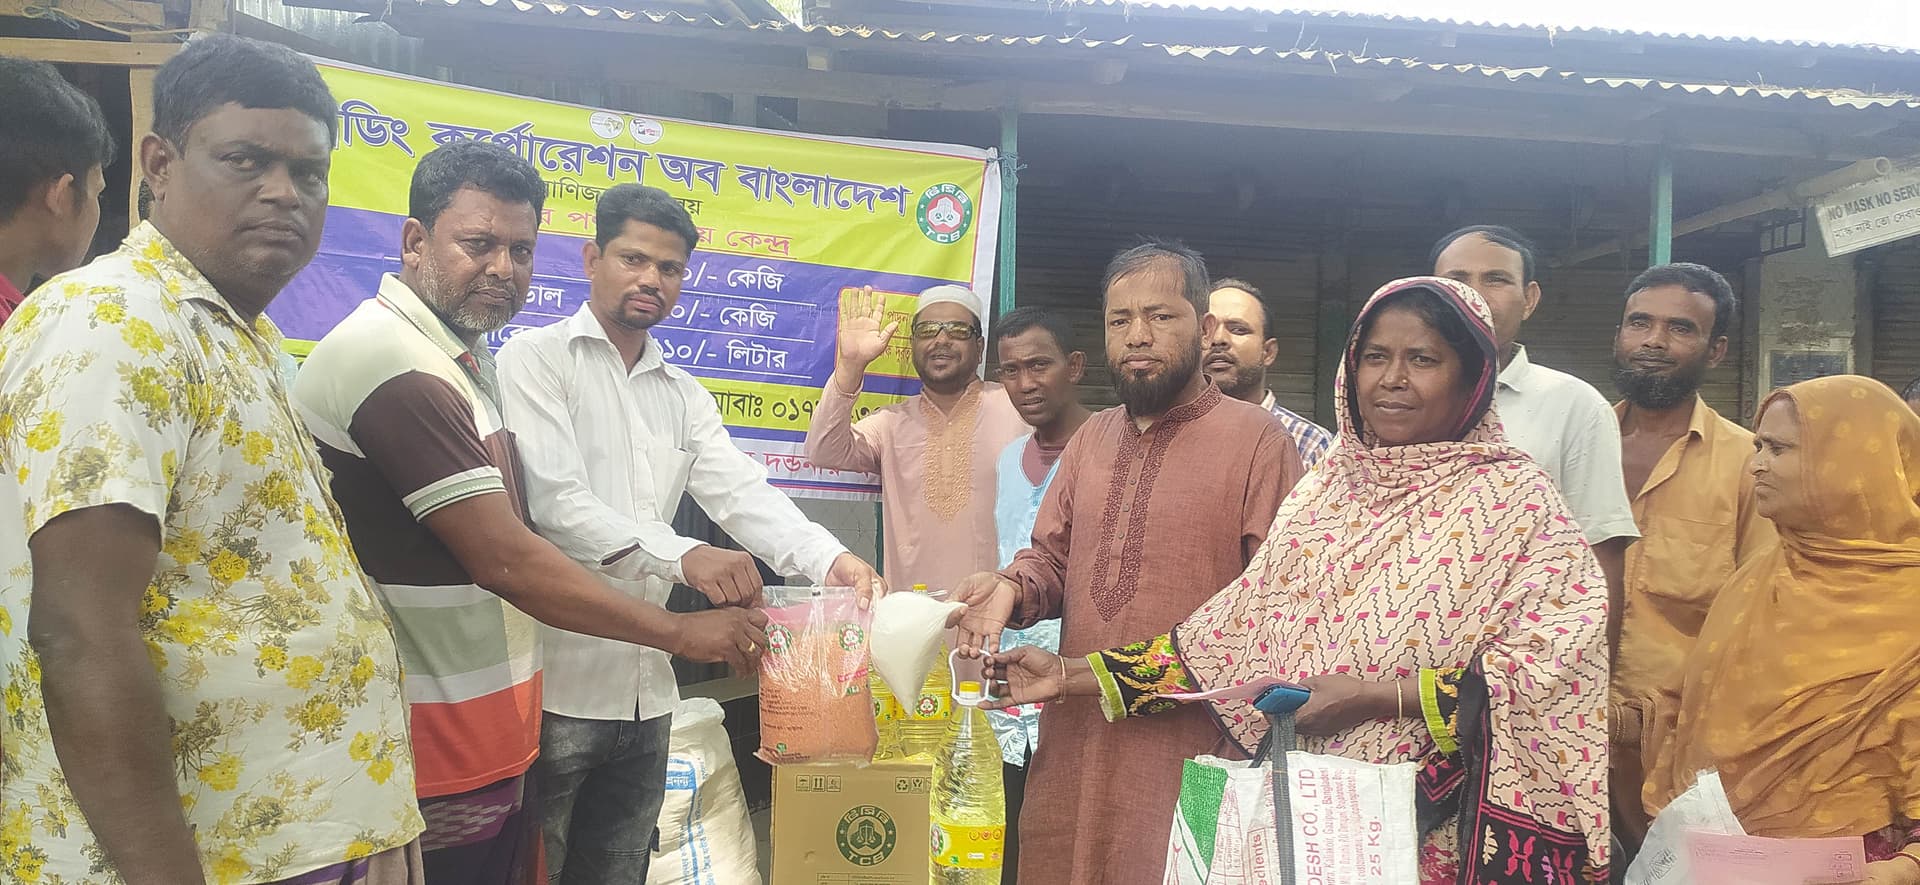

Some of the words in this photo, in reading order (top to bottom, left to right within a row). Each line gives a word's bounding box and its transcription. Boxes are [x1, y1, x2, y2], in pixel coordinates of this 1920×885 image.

[655, 153, 728, 195] অব
[735, 163, 914, 217] বাংলাদেশ
[1828, 206, 1843, 220] NO
[1844, 196, 1874, 215] MASK
[1876, 192, 1892, 207] NO
[726, 231, 792, 256] কেন্দ্র
[925, 226, 961, 243] TCB
[727, 265, 785, 293] কেজি
[720, 303, 778, 330] কেজি
[726, 339, 788, 369] লিটার
[1298, 768, 1318, 798] LTD
[1367, 815, 1383, 847] Kg.
[848, 850, 886, 866] TCB
[1369, 853, 1382, 876] 25
